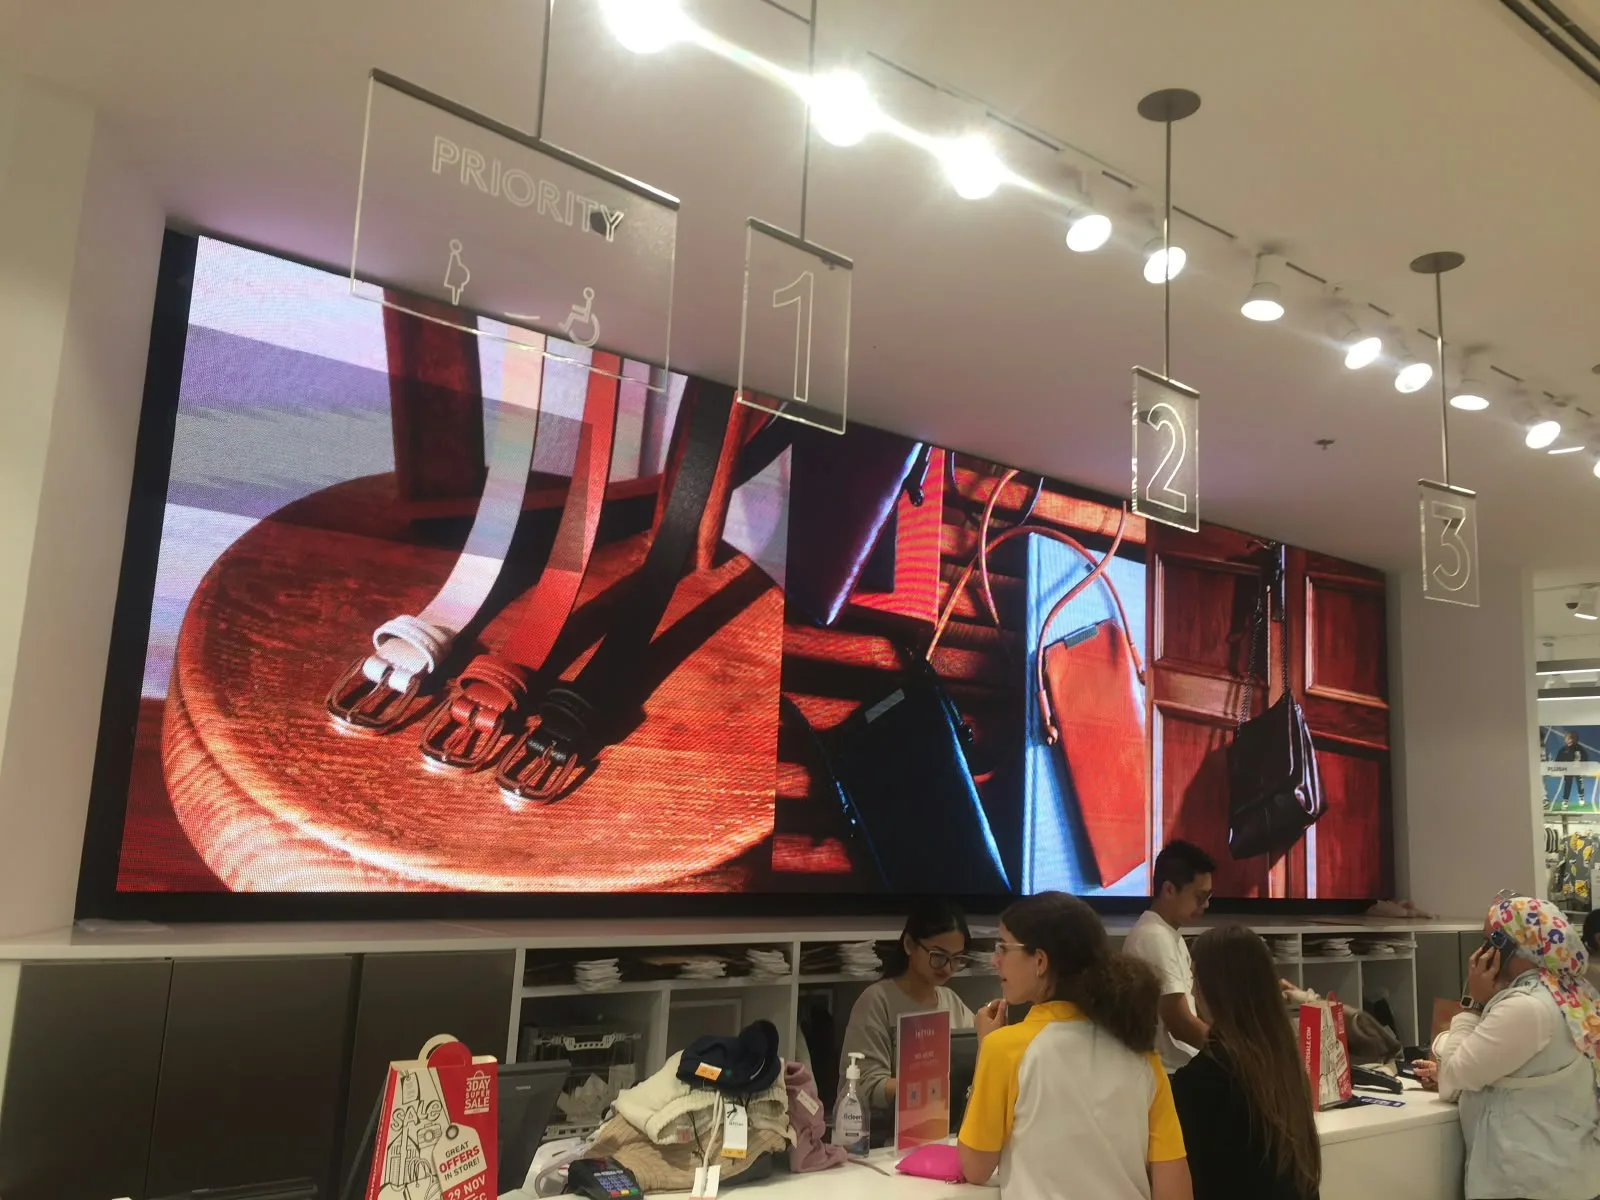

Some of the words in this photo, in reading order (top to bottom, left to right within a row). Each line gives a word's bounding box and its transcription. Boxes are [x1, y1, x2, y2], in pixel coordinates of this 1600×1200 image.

[431, 135, 625, 243] PRIORITY
[772, 270, 814, 403] 1
[1146, 402, 1187, 513] 2
[1431, 500, 1471, 592] 3
[465, 1089, 491, 1099] SUPER
[466, 1078, 491, 1092] 3DAY
[464, 1096, 490, 1110] SALE
[438, 1145, 480, 1174] OFFERS
[445, 1140, 470, 1158] GREAT
[444, 1171, 453, 1181] IN
[453, 1157, 480, 1178] STORE!
[464, 1174, 486, 1196] NOV
